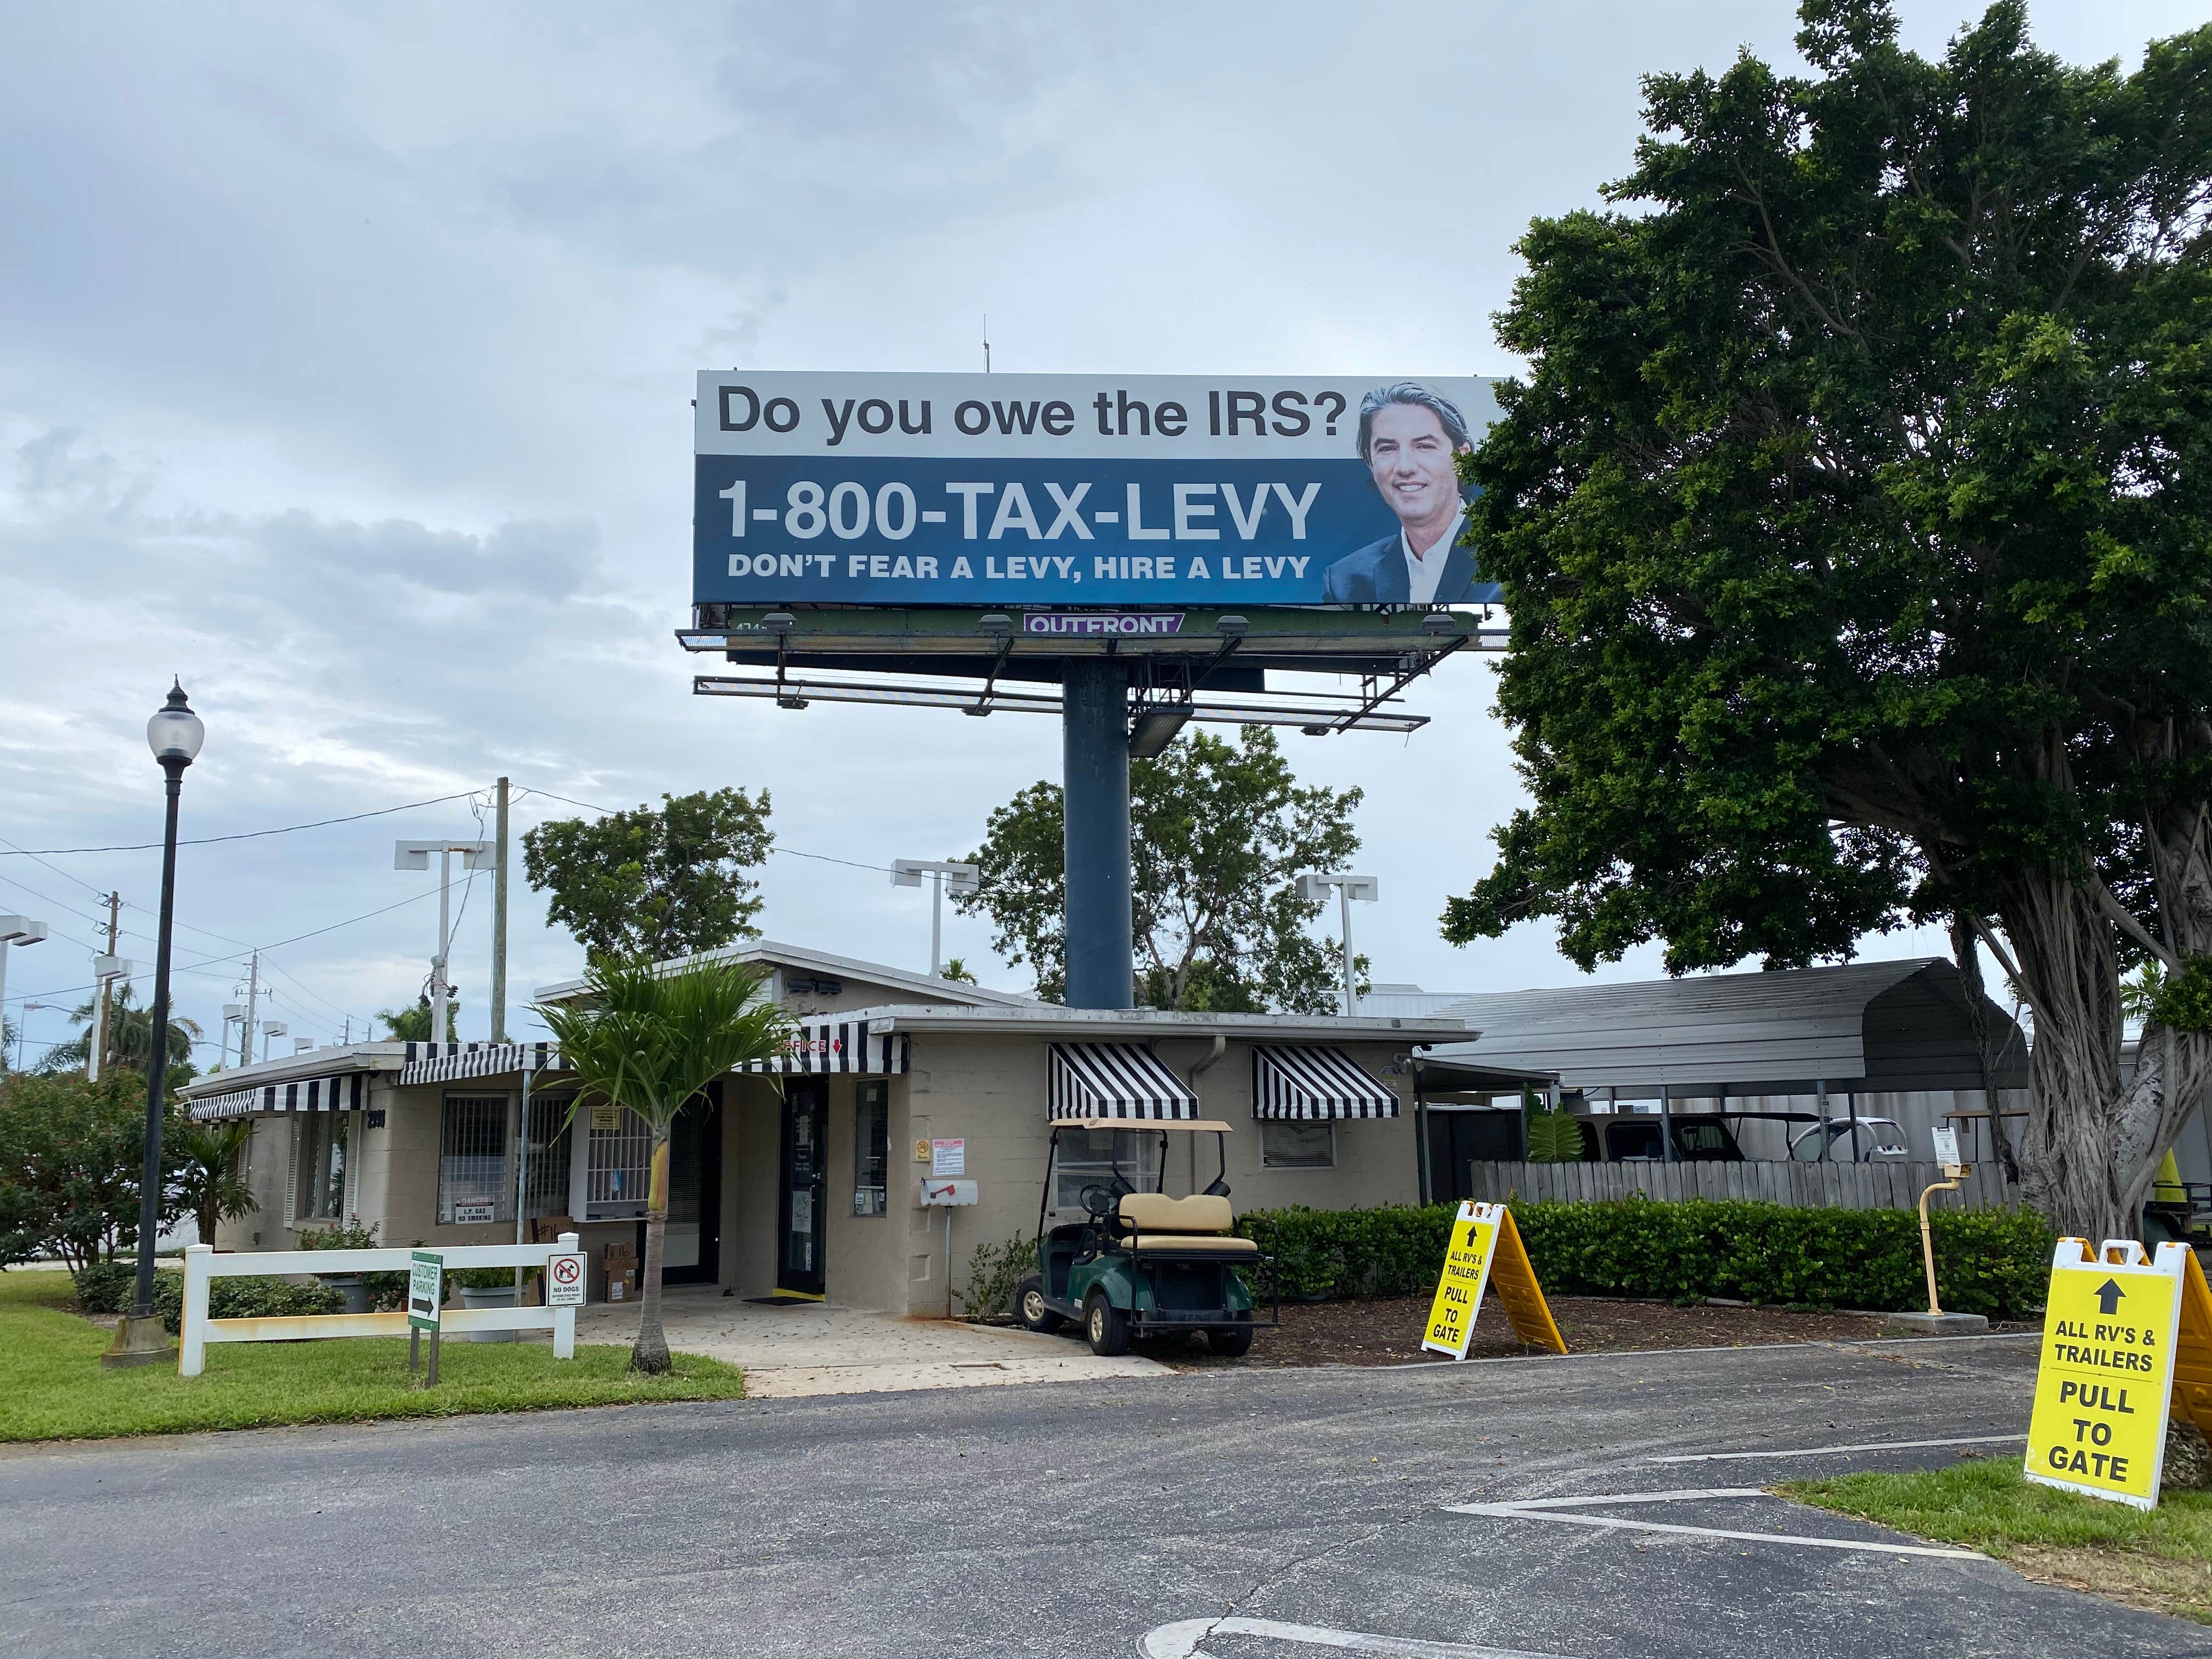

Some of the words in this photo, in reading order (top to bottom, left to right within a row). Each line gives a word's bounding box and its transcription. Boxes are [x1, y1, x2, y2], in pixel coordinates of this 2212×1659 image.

[718, 385, 800, 433] Do
[821, 398, 932, 446] you
[954, 400, 1075, 436] owe
[1093, 390, 1188, 437] the
[1209, 390, 1347, 437] IRS?
[719, 480, 1322, 540] 1-800-TAX-LEVY
[727, 553, 836, 577] DON'T
[848, 555, 939, 579] FEAR
[950, 556, 974, 579] A
[986, 556, 1082, 584] LEVY,
[1094, 556, 1176, 579] HIRE
[1187, 556, 1211, 579] A
[1222, 556, 1311, 579] LEVY
[1030, 616, 1175, 632] OUTFRONT
[774, 1040, 826, 1052] FFICE
[461, 1197, 489, 1205] DANGER
[1450, 1251, 1461, 1262] ALL
[1463, 1252, 1477, 1265] RV'S
[1477, 1255, 1482, 1265] &
[412, 1263, 437, 1280] CUSTOMER
[1448, 1265, 1479, 1280] TRAILERS
[413, 1279, 435, 1295] PARKING
[1444, 1286, 1468, 1305] PULL
[1445, 1308, 1458, 1323] TO
[1433, 1324, 1460, 1343] GATE
[2055, 1321, 2088, 1339] ALL
[2095, 1324, 2136, 1344] RV'S
[2142, 1329, 2155, 1346] &
[2055, 1344, 2153, 1372] TRAILERS
[2059, 1380, 2134, 1414] PULL
[2073, 1418, 2112, 1446] TO
[2049, 1446, 2129, 1482] GATE
